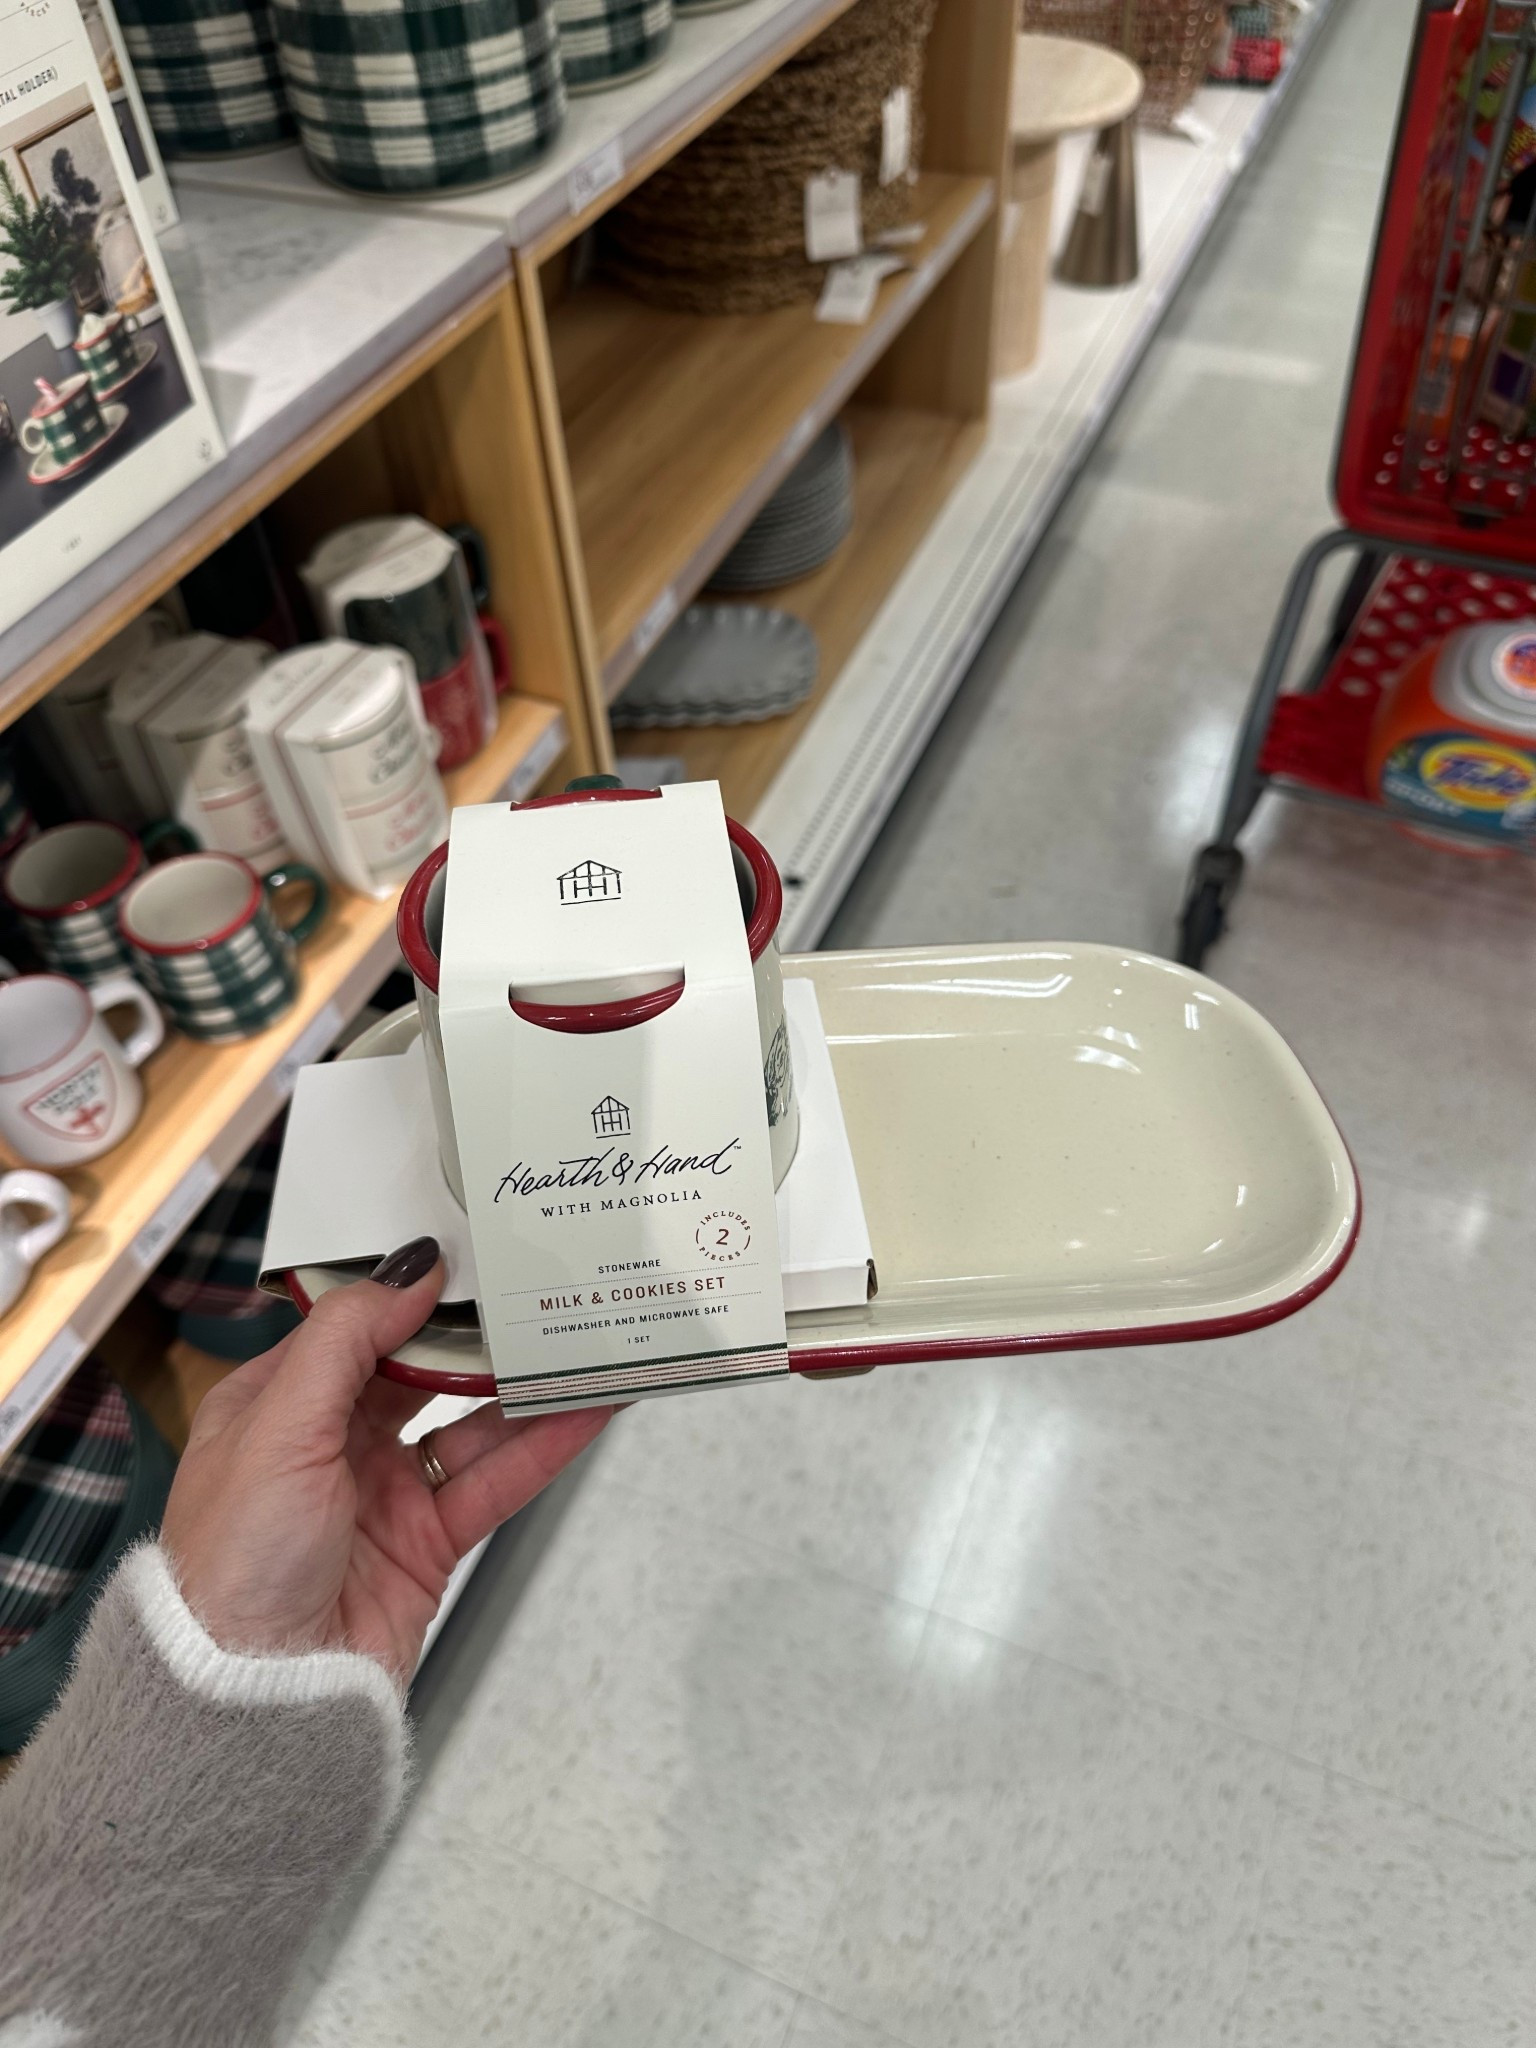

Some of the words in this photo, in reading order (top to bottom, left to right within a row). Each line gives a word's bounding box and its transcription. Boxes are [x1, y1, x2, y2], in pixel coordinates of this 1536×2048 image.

[0, 88, 17, 108] TAL
[494, 1147, 615, 1203] Hearth
[612, 1152, 634, 1186] &
[541, 1202, 592, 1218] WITH
[600, 1189, 702, 1211] MAGNOLIA
[699, 1210, 751, 1232] INCLUDES
[715, 1228, 730, 1246] 2
[699, 1246, 741, 1262] PIECES
[598, 1258, 661, 1274] STONEWARE
[540, 1293, 583, 1311] MILK
[591, 1291, 604, 1304] &
[611, 1281, 687, 1302] COOKIES
[694, 1276, 726, 1292] SET
[542, 1319, 611, 1336] DISHWASHER
[614, 1316, 636, 1326] AND
[639, 1307, 701, 1323] MICROWAVE
[704, 1304, 730, 1315] SAFE
[634, 1335, 651, 1344] SET
